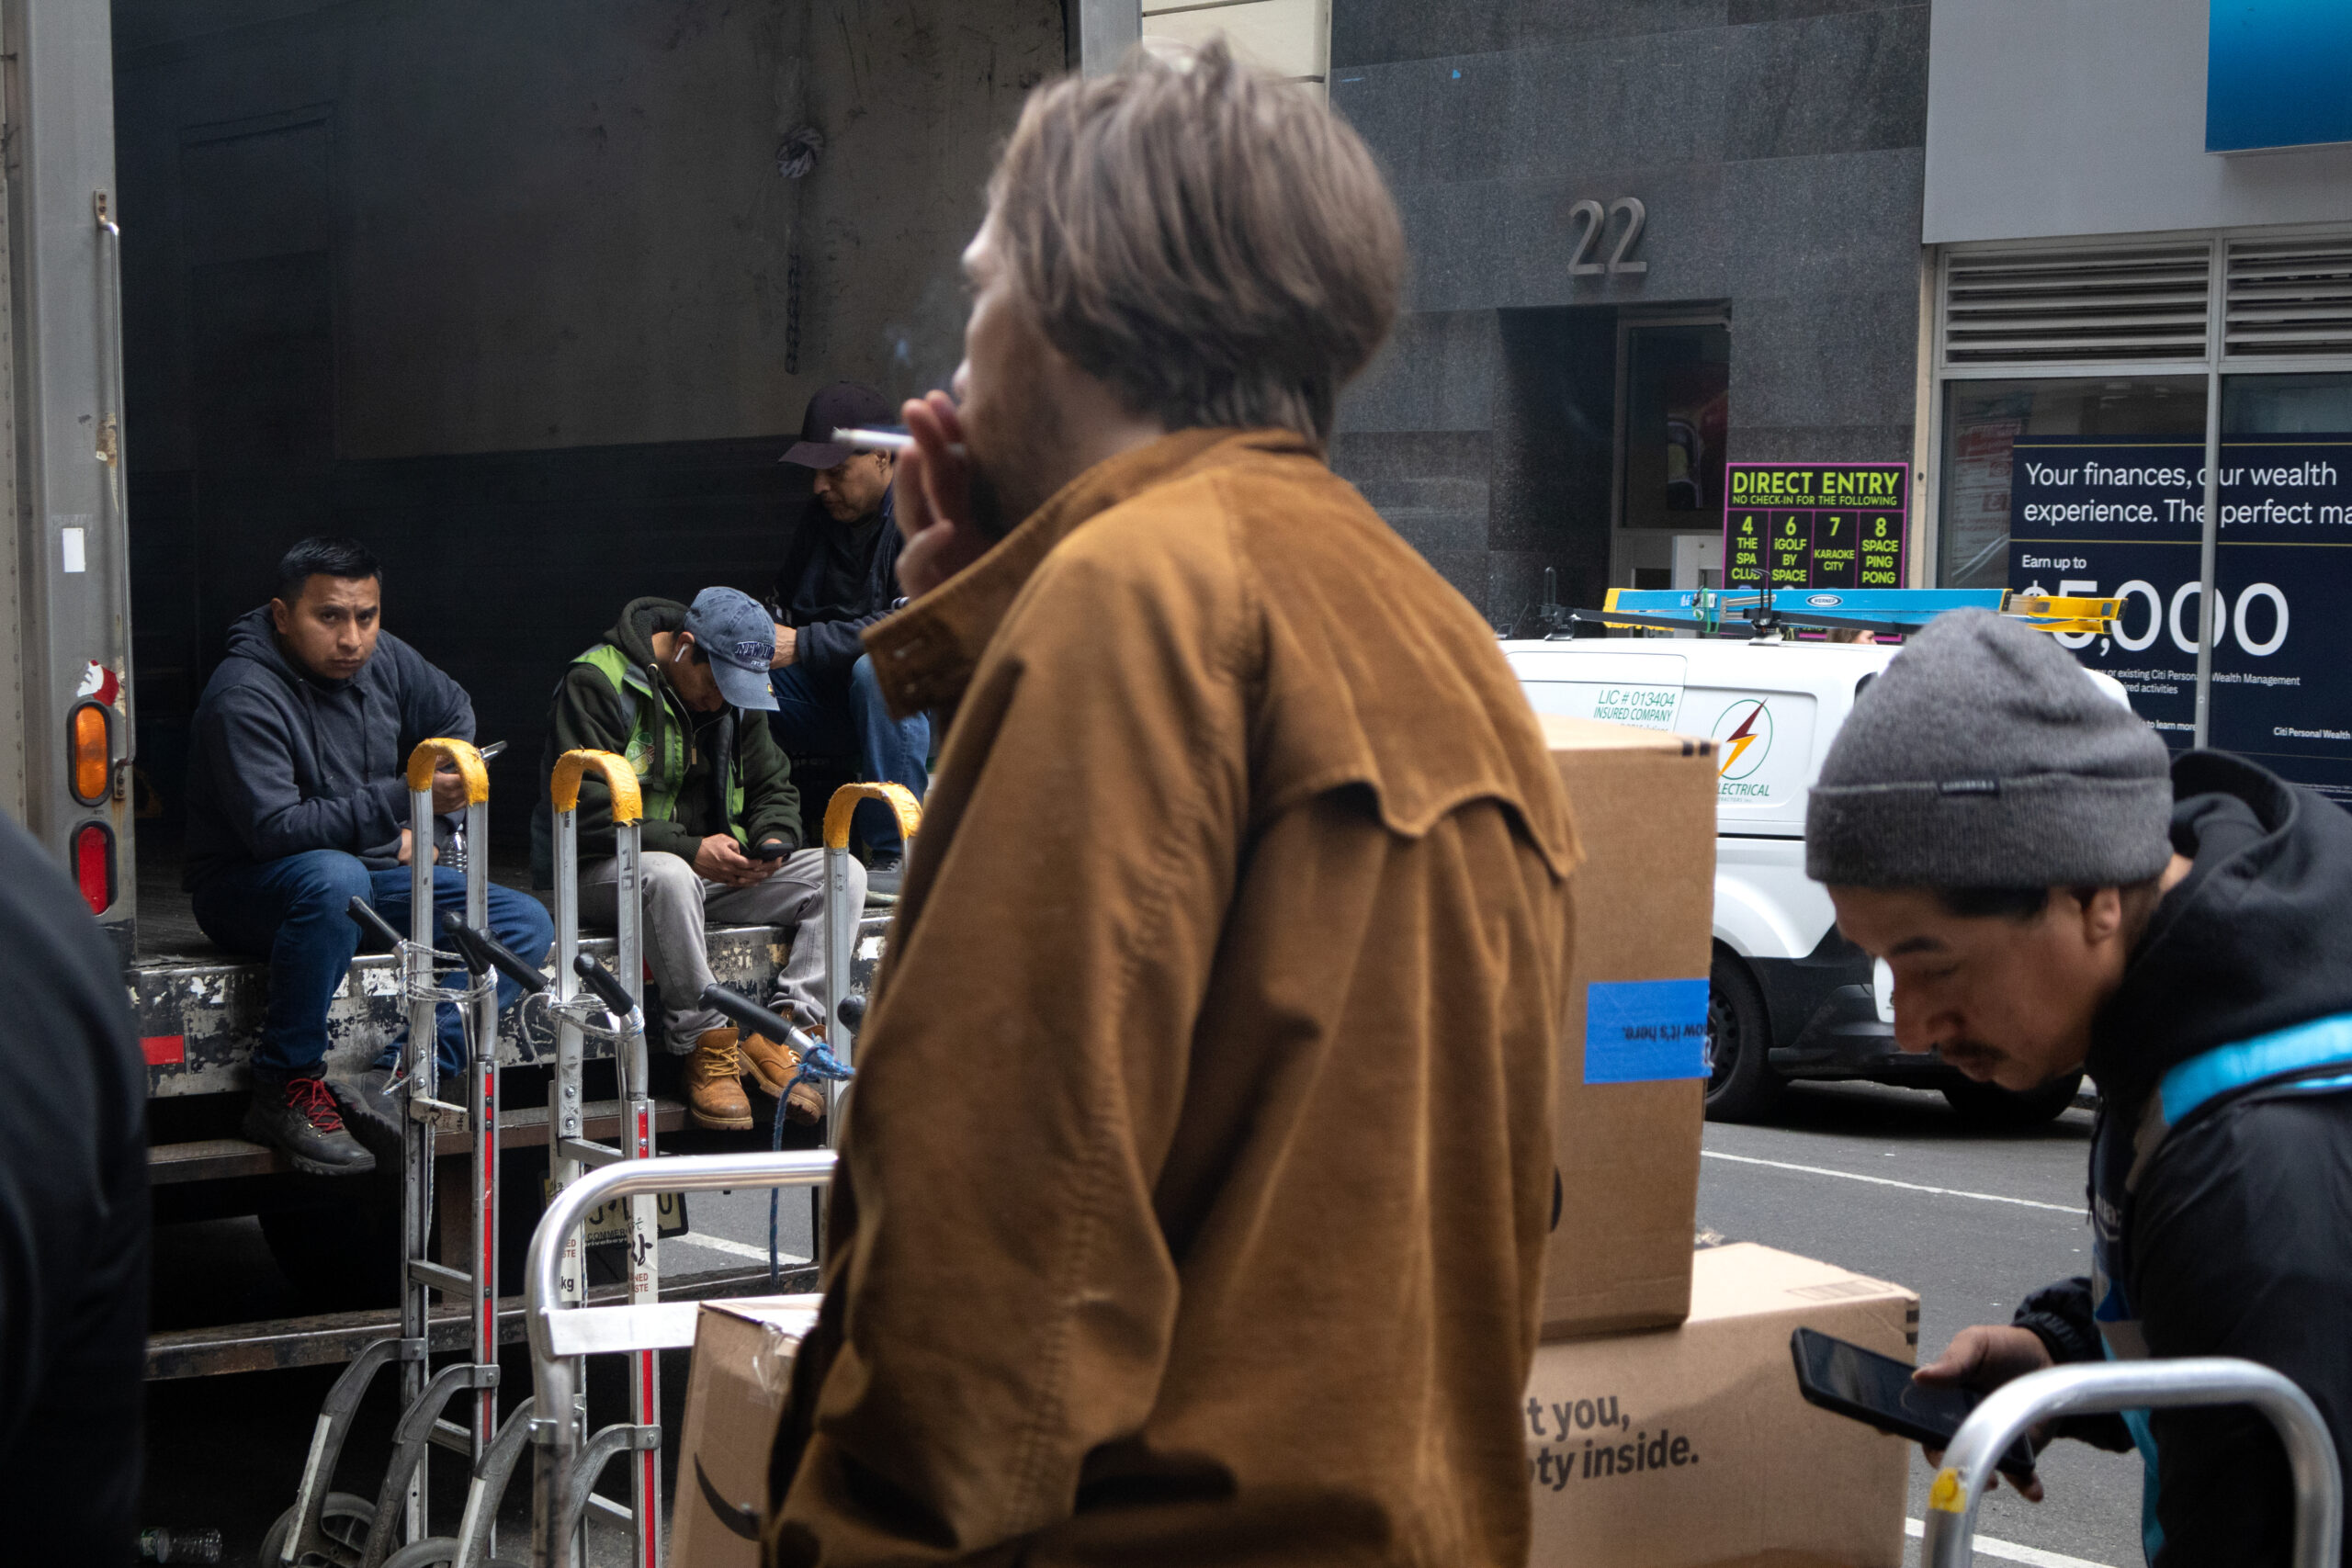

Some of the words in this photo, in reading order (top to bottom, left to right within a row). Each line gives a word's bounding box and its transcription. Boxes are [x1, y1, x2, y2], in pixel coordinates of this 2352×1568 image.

[1567, 197, 1646, 275] 22
[2025, 463, 2078, 486] Your
[2084, 462, 2192, 490] finances,
[2250, 461, 2336, 486] wealth
[1733, 472, 1813, 493] DIRECT
[1823, 472, 1899, 494] ENTRY
[1733, 495, 1747, 504] NO
[1750, 495, 1793, 504] CHECK-IN
[1796, 495, 1815, 504] FOR
[1818, 496, 1837, 505] THE
[1839, 496, 1897, 505] FOLLOWING
[2024, 499, 2158, 526] experience.
[2164, 499, 2205, 523] The
[2221, 499, 2312, 528] perfect
[1742, 515, 1753, 535] 4
[1785, 516, 1796, 536] 6
[1829, 517, 1840, 536] 7
[1874, 517, 1887, 537] 8
[1736, 537, 1758, 548] THE
[1774, 538, 1807, 550] iGOLF
[1861, 540, 1898, 552] SPACE
[1736, 553, 1757, 565] SPA
[1782, 554, 1797, 566] BY
[1814, 549, 1855, 559] KARAOKE
[1824, 561, 1845, 570] CITY
[1866, 556, 1894, 568] PING
[2022, 555, 2051, 569] Earn
[2053, 558, 2071, 570] up
[2073, 557, 2087, 569] to
[1771, 570, 1806, 581] SPACE
[1862, 571, 1895, 583] PONG
[2022, 580, 2289, 656] 5,000
[2118, 669, 2150, 681] existing
[2151, 669, 2166, 680] Citi
[2168, 671, 2198, 681] Person
[2211, 672, 2242, 682] Wealth
[2244, 673, 2301, 686] Management
[2123, 682, 2140, 692] ired
[2141, 683, 2178, 694] activities
[1599, 690, 1620, 705] LIC
[1622, 693, 1630, 705] #
[1631, 691, 1675, 707] 013404
[1594, 707, 1629, 720] INSURED
[1630, 708, 1672, 722] COMPANY
[2155, 719, 2176, 730] learn
[2274, 727, 2288, 736] Citi
[2289, 728, 2322, 739] Personal
[2323, 729, 2350, 739] Wealth
[1717, 783, 1770, 796] LECTRICAL
[588, 1228, 628, 1240] COMMER
[1553, 1395, 1630, 1442] you,
[1583, 1429, 1700, 1479] inside.
